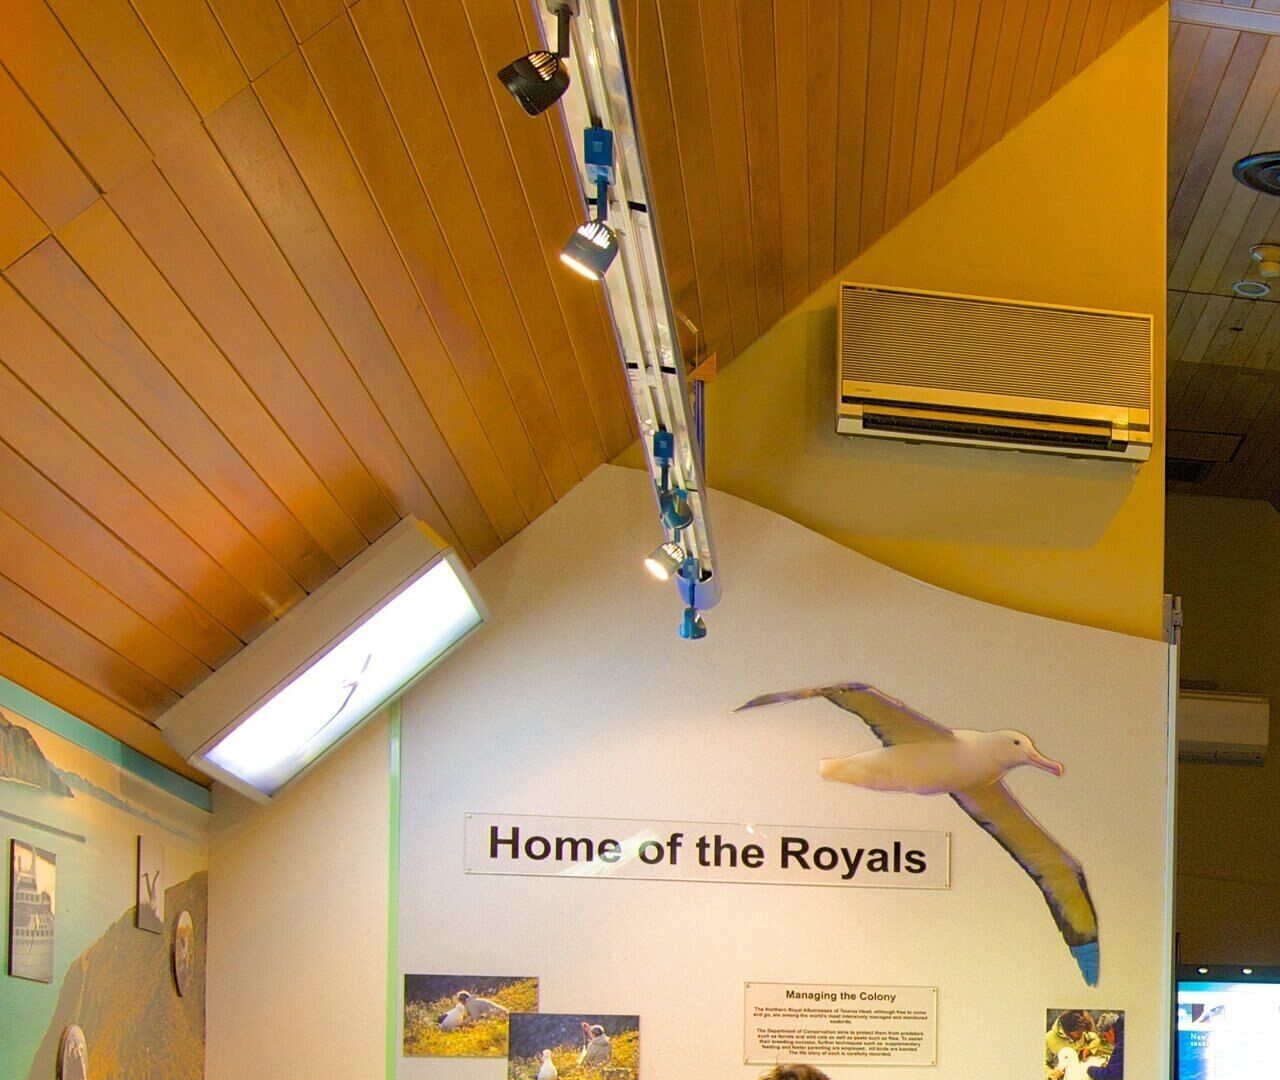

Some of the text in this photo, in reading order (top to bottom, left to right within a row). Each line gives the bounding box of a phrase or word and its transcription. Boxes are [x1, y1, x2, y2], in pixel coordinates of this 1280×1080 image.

[489, 825, 927, 879] Home of the Royals
[786, 990, 896, 1003] Managing the Colony
